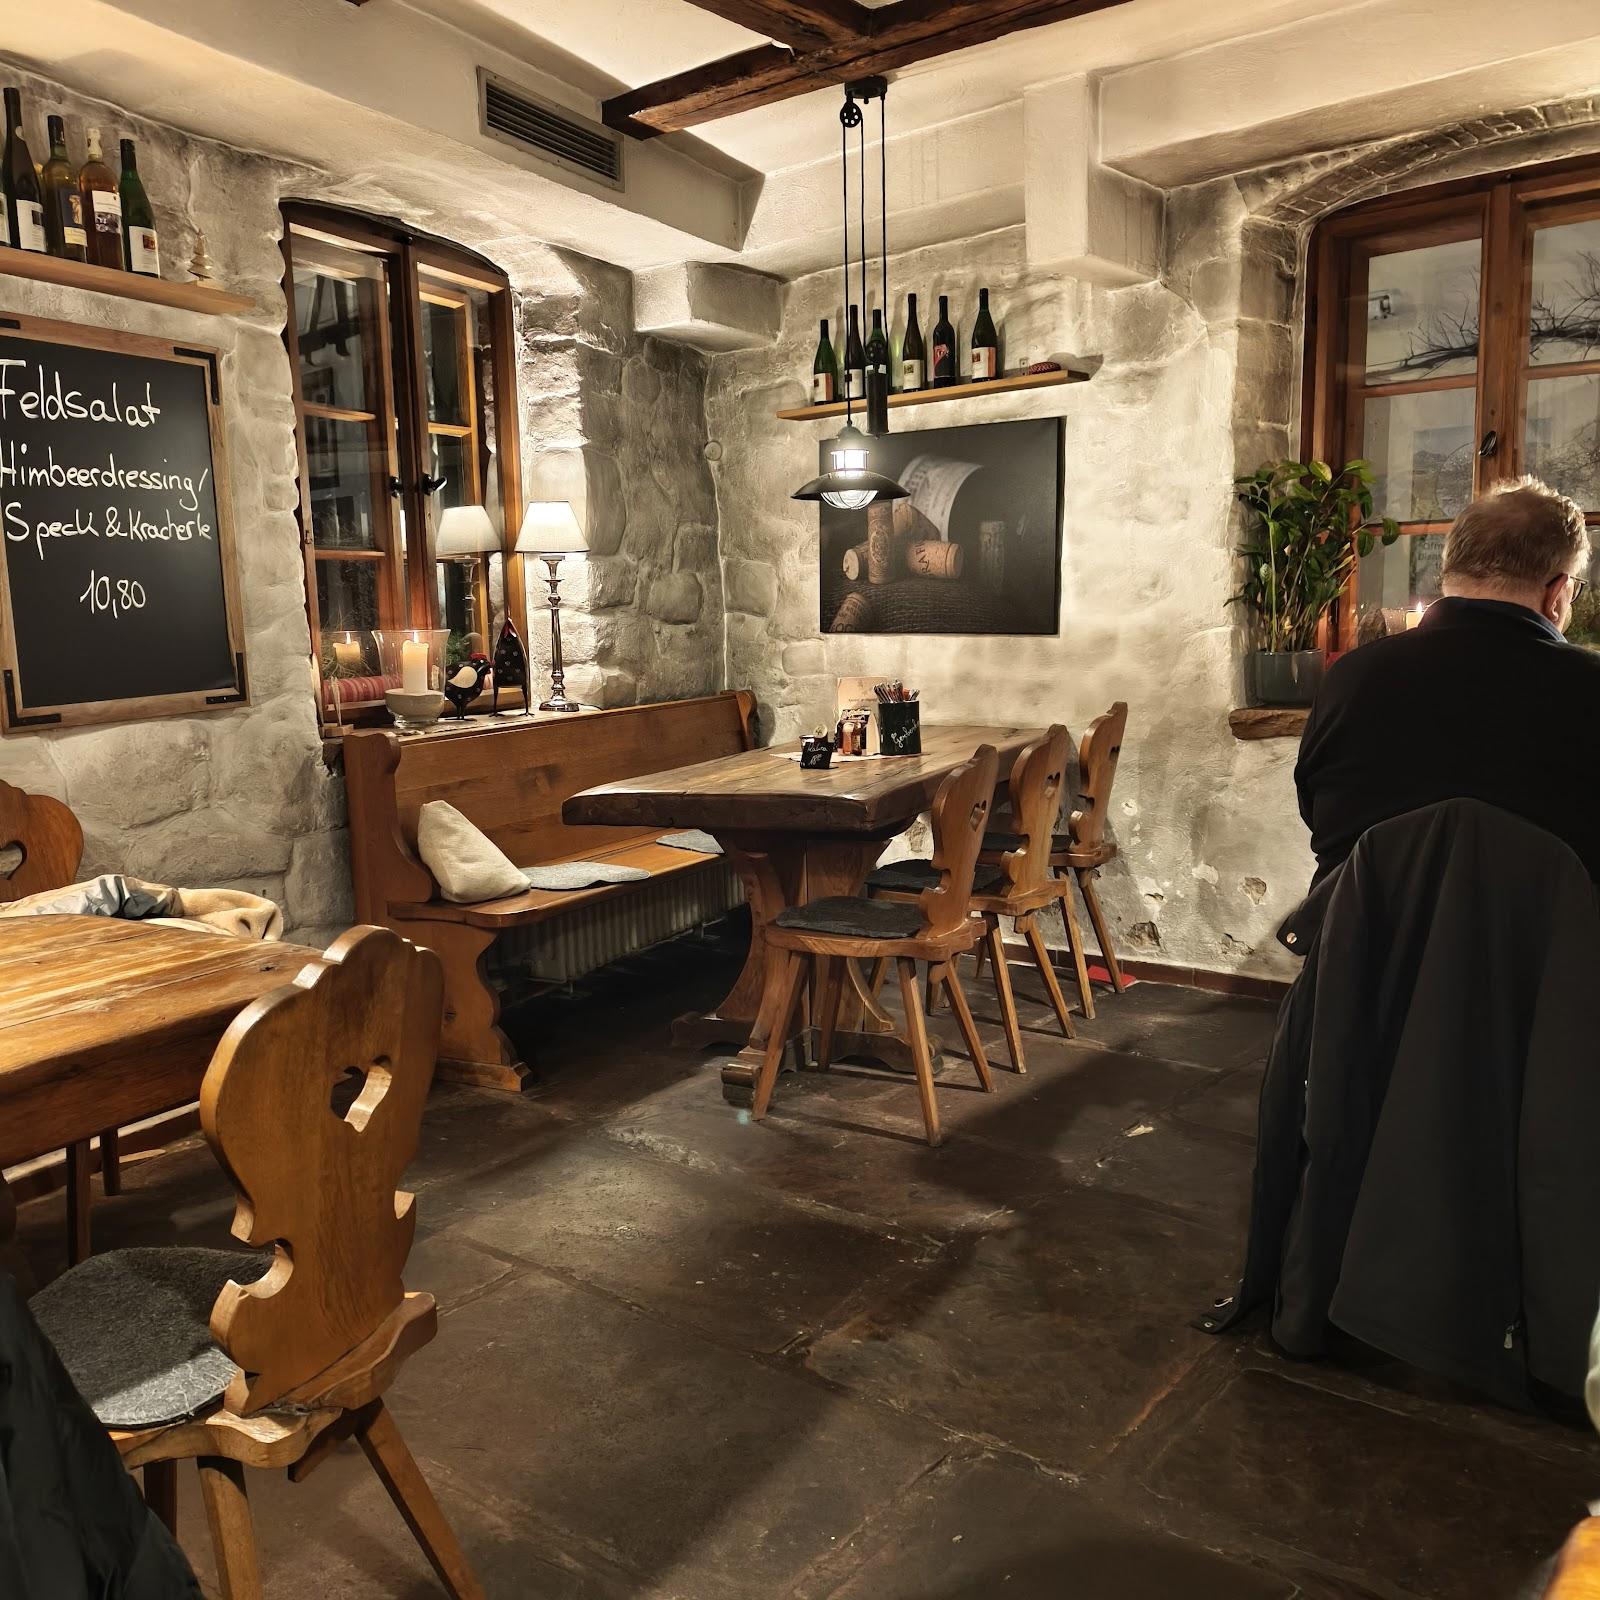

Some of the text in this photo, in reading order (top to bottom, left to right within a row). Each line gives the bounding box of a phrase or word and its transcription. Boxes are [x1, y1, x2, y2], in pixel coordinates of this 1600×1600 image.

[0, 359, 161, 427] Feldsalat
[5, 502, 100, 560] Speck
[80, 569, 146, 619] 10,80
